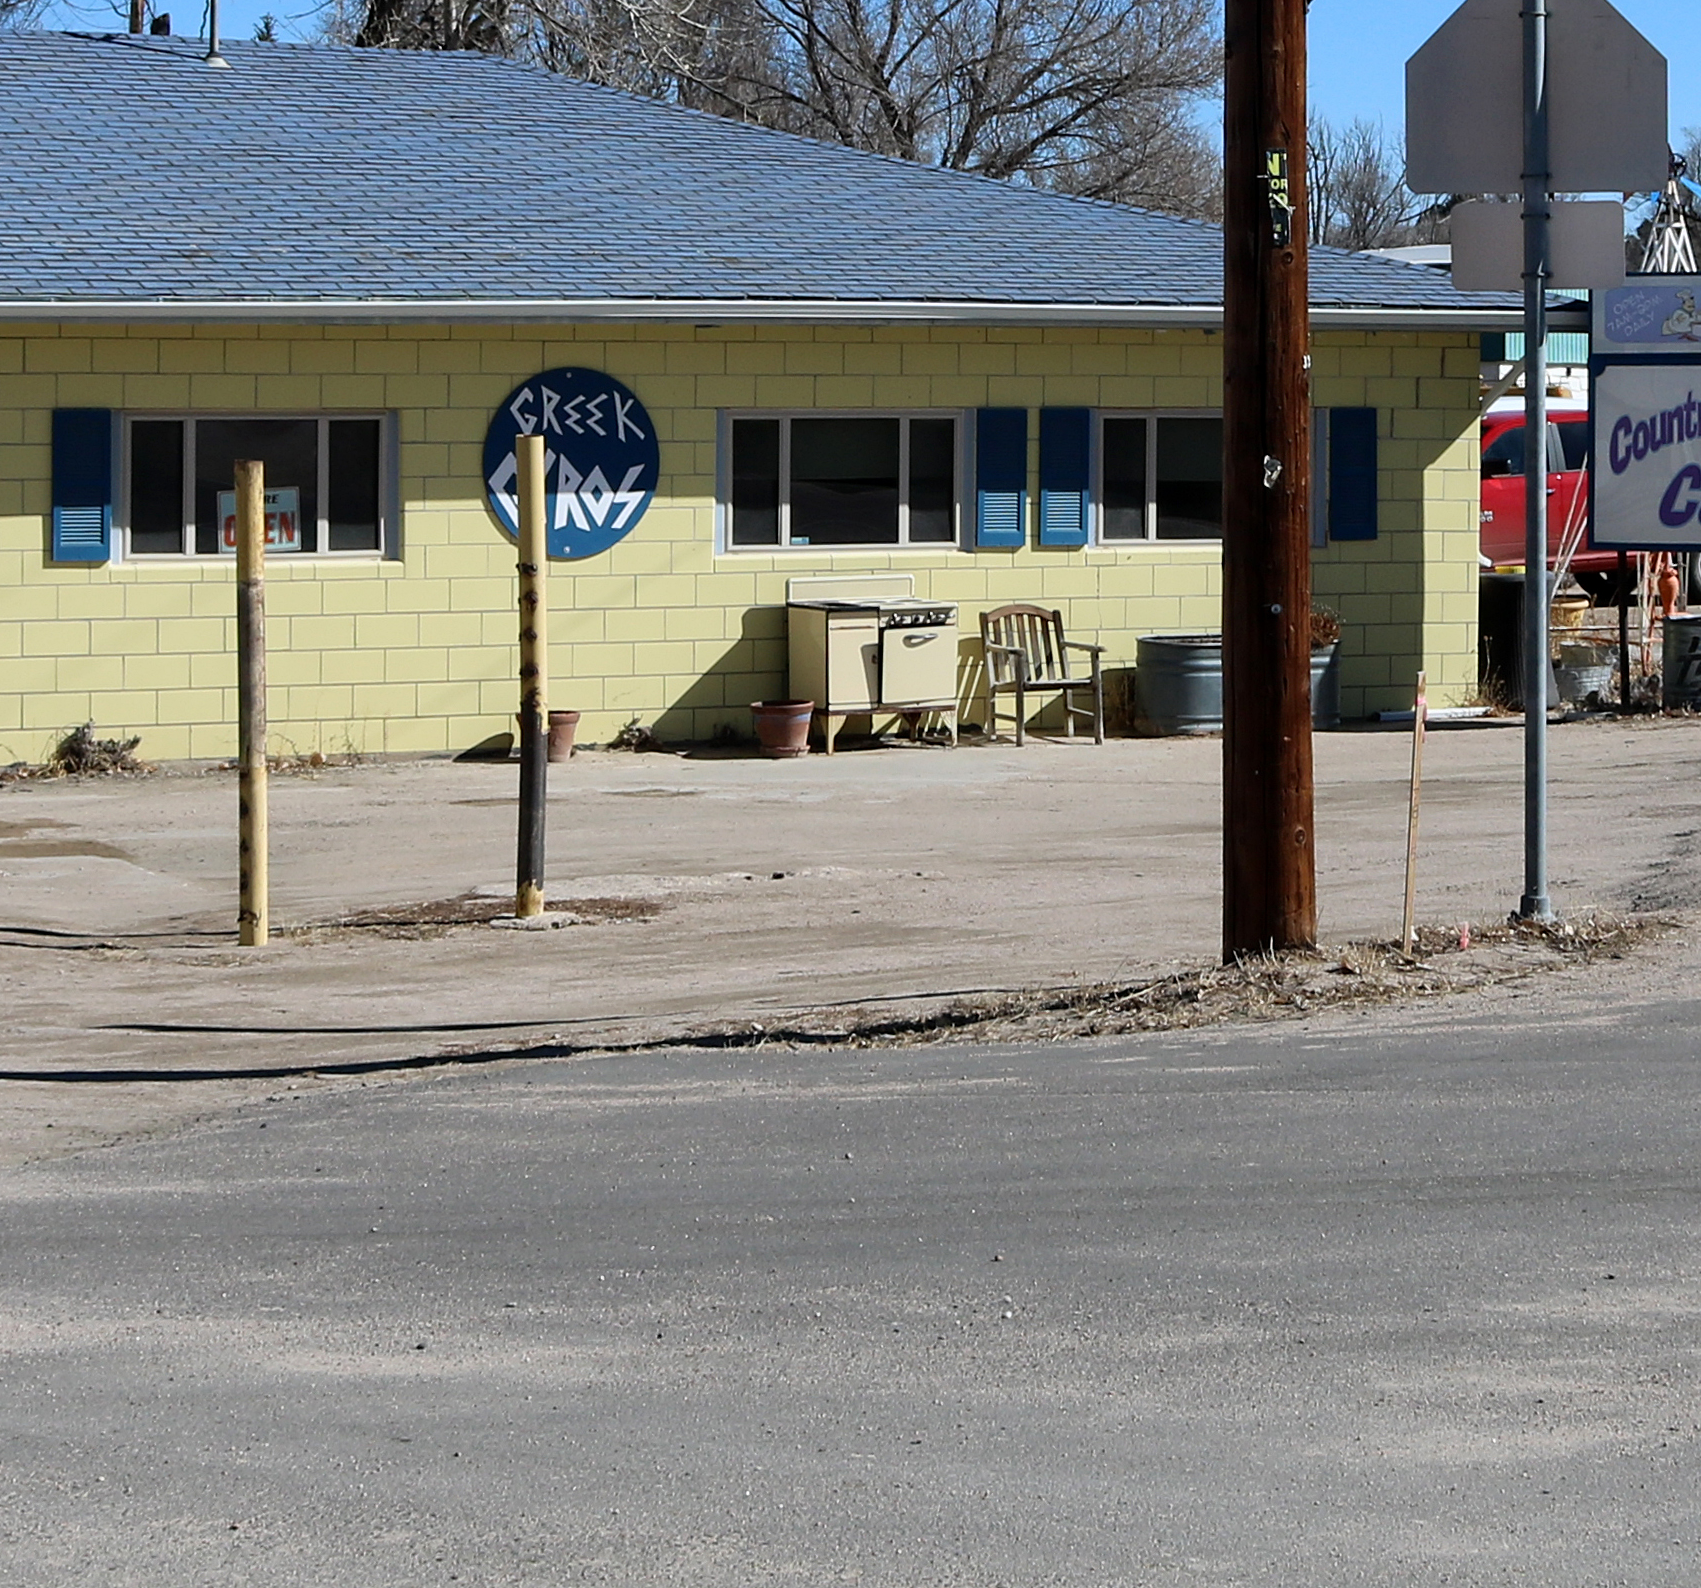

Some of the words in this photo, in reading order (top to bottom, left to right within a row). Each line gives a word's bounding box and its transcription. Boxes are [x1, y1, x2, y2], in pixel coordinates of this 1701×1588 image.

[1613, 290, 1645, 315] OPEN
[1624, 310, 1655, 337] DAILY
[509, 384, 646, 444] GREEK
[487, 446, 647, 532] GROS
[224, 511, 296, 548] OEN
